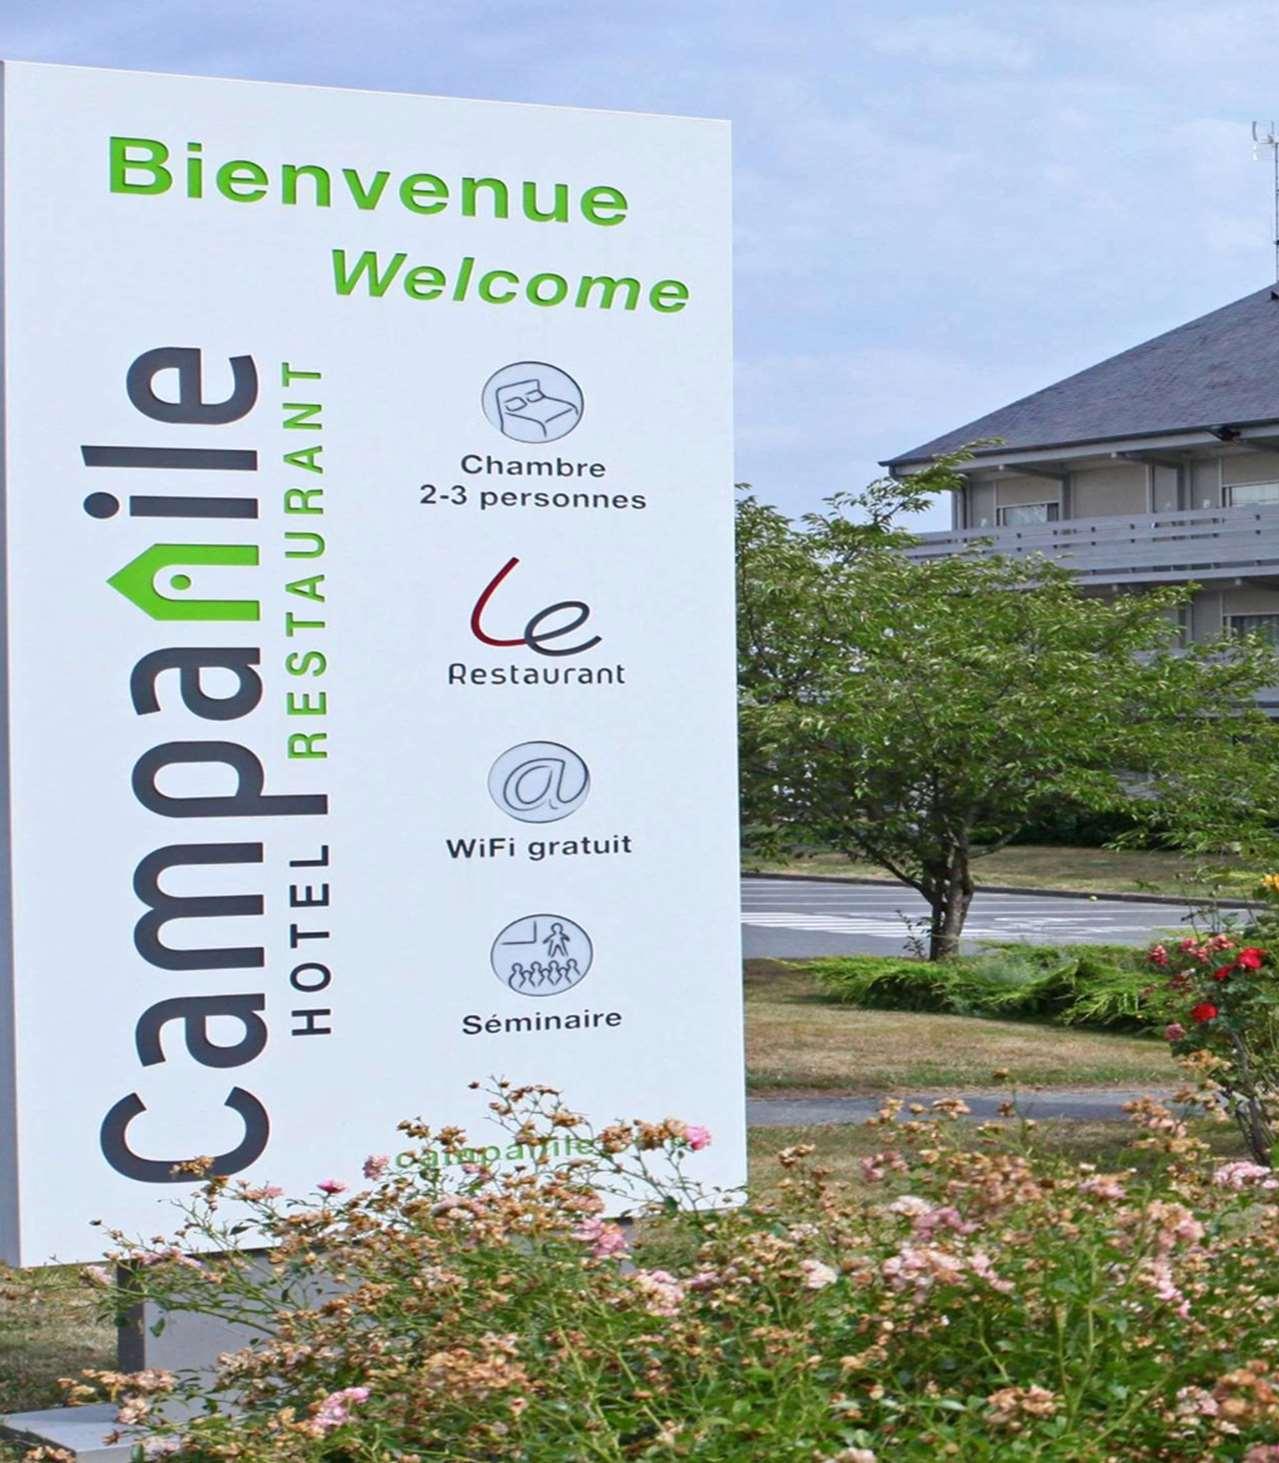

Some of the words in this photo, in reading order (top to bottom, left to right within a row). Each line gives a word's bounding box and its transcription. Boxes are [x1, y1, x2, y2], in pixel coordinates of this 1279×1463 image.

[109, 135, 629, 228] Bienvenue
[331, 248, 690, 314] Welcome
[419, 483, 468, 507] 2-3
[480, 489, 647, 512] personnes
[460, 454, 606, 478] Chambre
[281, 361, 328, 760] RESTAURANT
[470, 556, 603, 658] Le
[448, 662, 626, 686] Restaurant
[80, 346, 329, 1185] Campanile
[445, 837, 516, 859] WiFi
[527, 834, 632, 862] gratuit
[289, 844, 332, 1037] HOTEL
[462, 1011, 623, 1036] Séminaire
